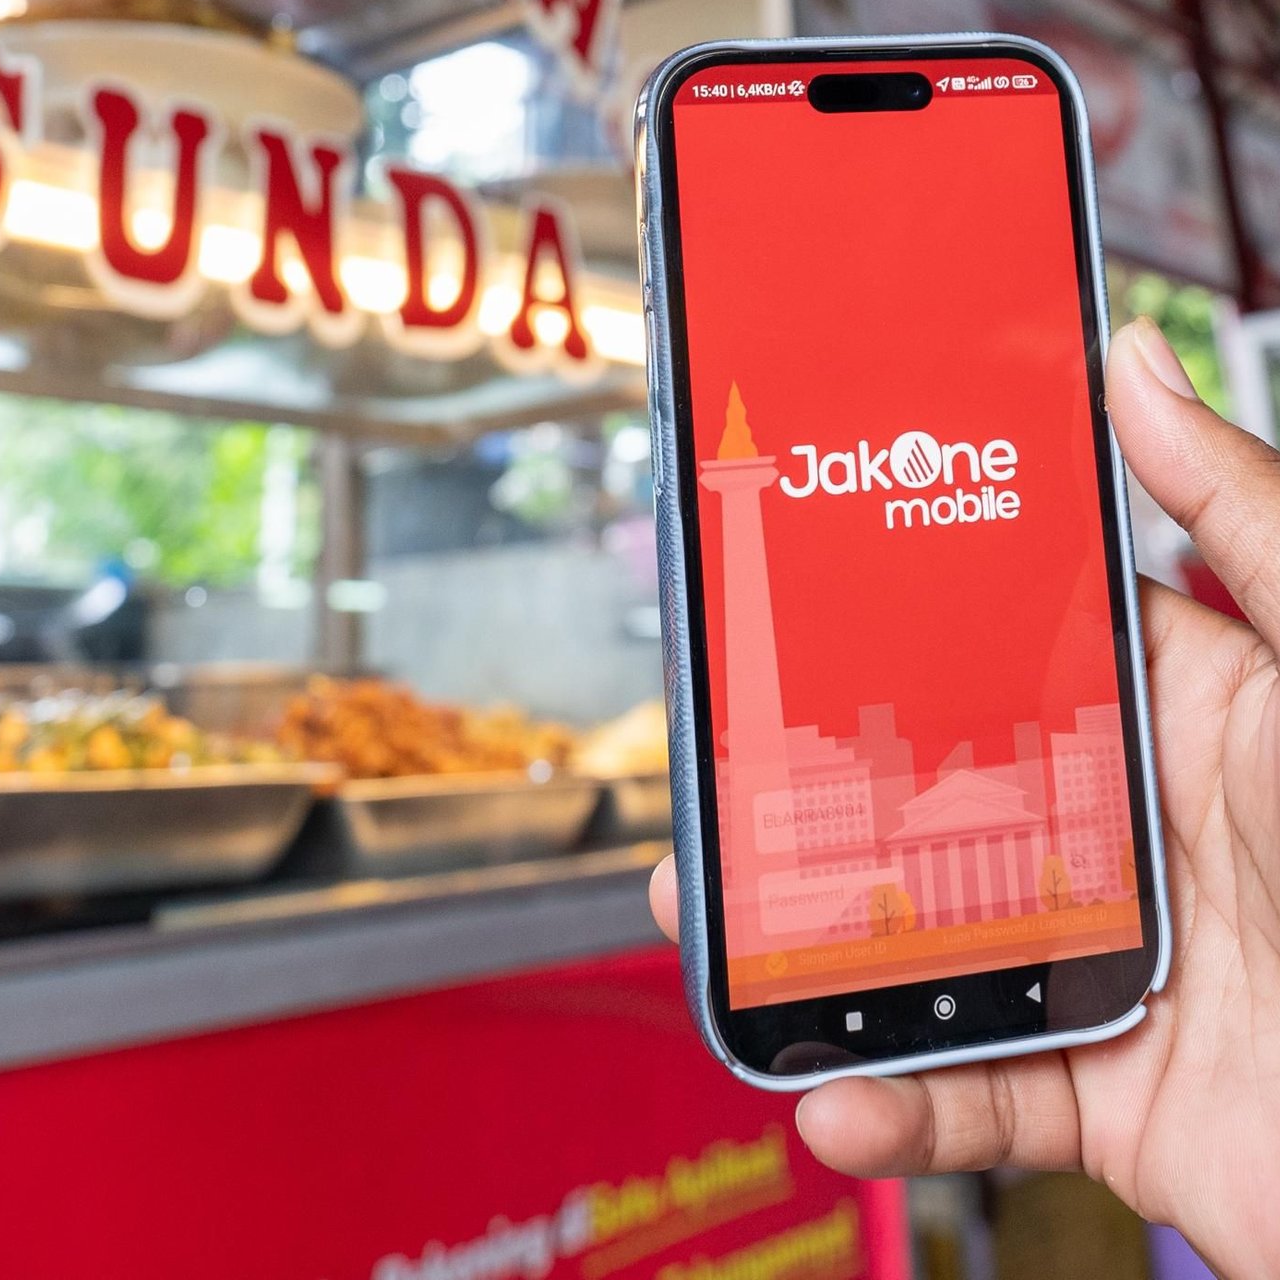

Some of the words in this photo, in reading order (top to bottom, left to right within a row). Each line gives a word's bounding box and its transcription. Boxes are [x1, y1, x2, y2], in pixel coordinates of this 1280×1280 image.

[692, 84, 728, 98] 15:40
[737, 83, 786, 98] 6,4KB/d
[779, 430, 1018, 498] JakOne
[884, 485, 1021, 529] mobile
[768, 883, 845, 909] Password
[799, 950, 843, 966] Simpan
[845, 944, 872, 960] User
[874, 941, 888, 955] ID
